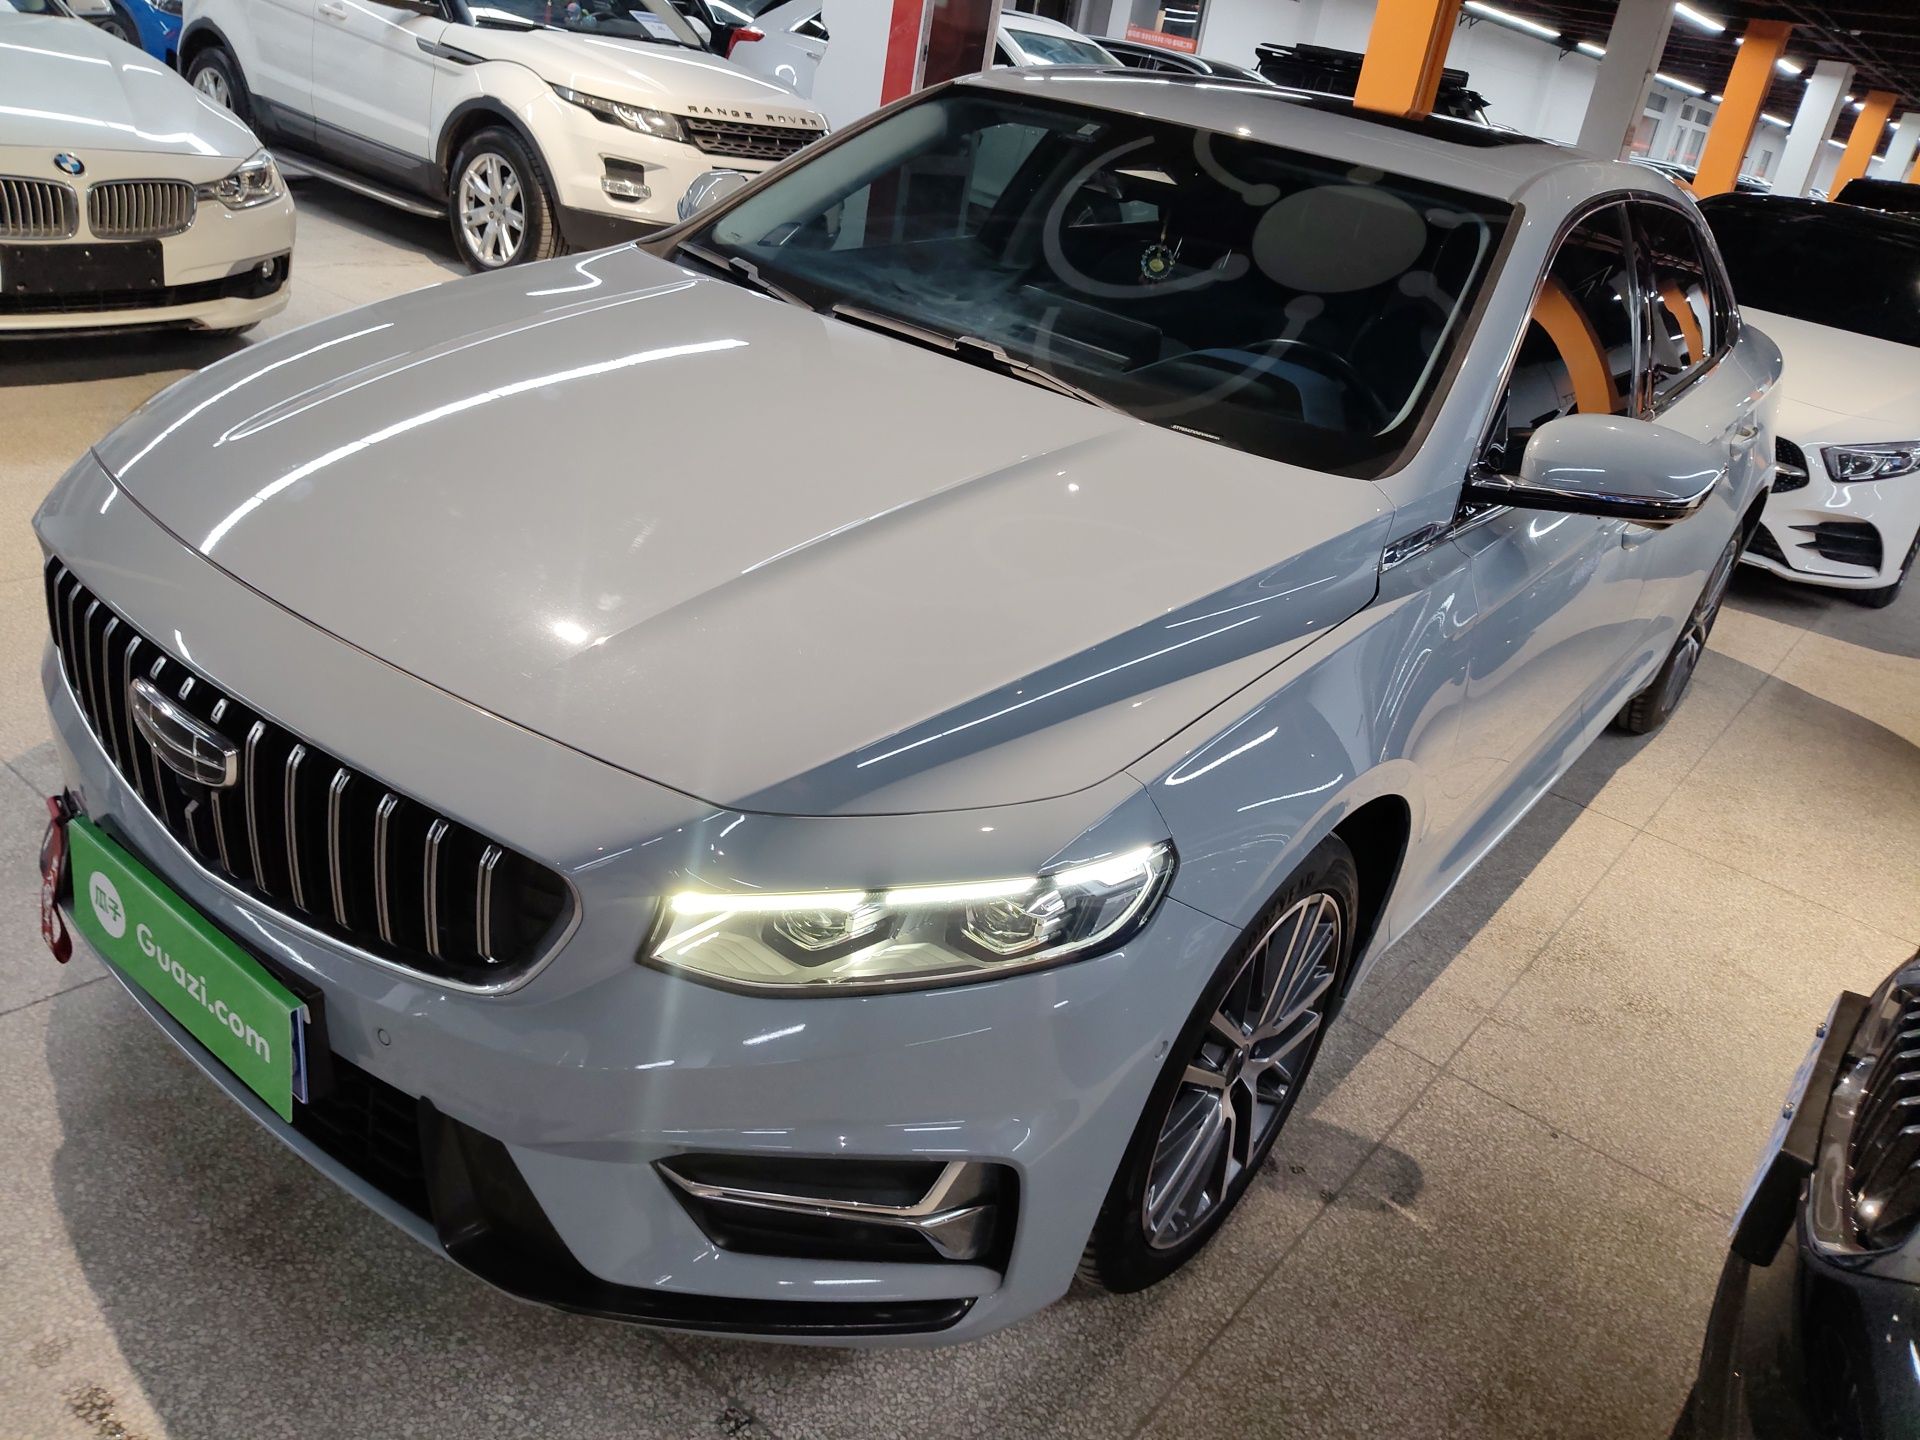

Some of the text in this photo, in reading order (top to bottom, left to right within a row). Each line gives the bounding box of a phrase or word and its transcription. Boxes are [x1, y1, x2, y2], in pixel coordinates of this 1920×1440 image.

[688, 105, 818, 127] RANGE ROVER
[95, 885, 122, 922] 瓜子
[136, 923, 271, 1064] Guazi.com
